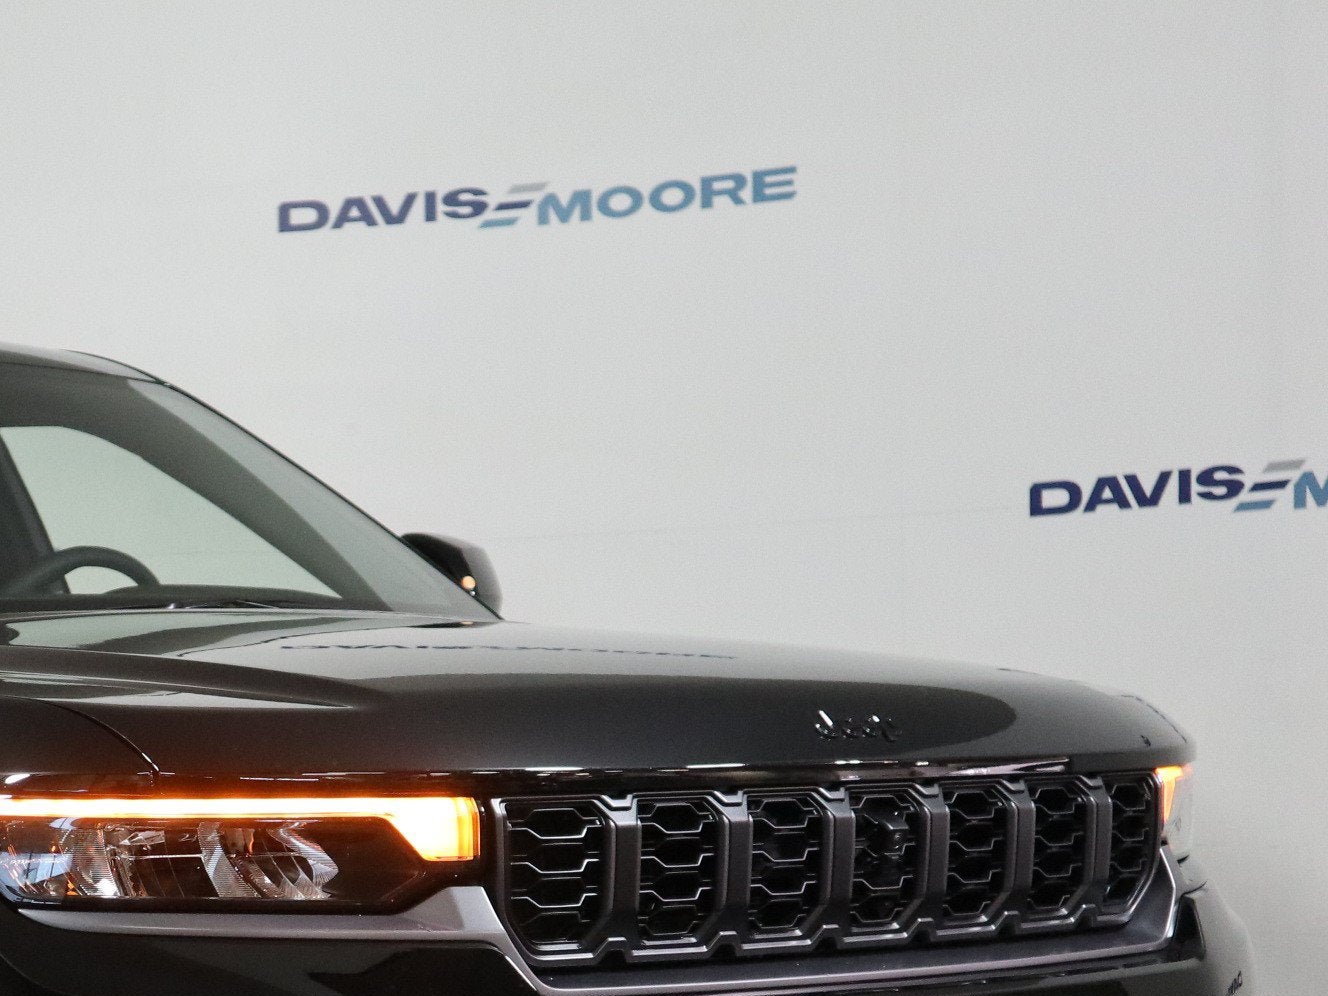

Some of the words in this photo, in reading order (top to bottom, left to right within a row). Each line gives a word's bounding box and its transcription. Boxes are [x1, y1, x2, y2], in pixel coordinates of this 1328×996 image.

[276, 186, 488, 233] DAVIS
[536, 165, 798, 227] MOORE
[1029, 464, 1246, 518] DAVIS
